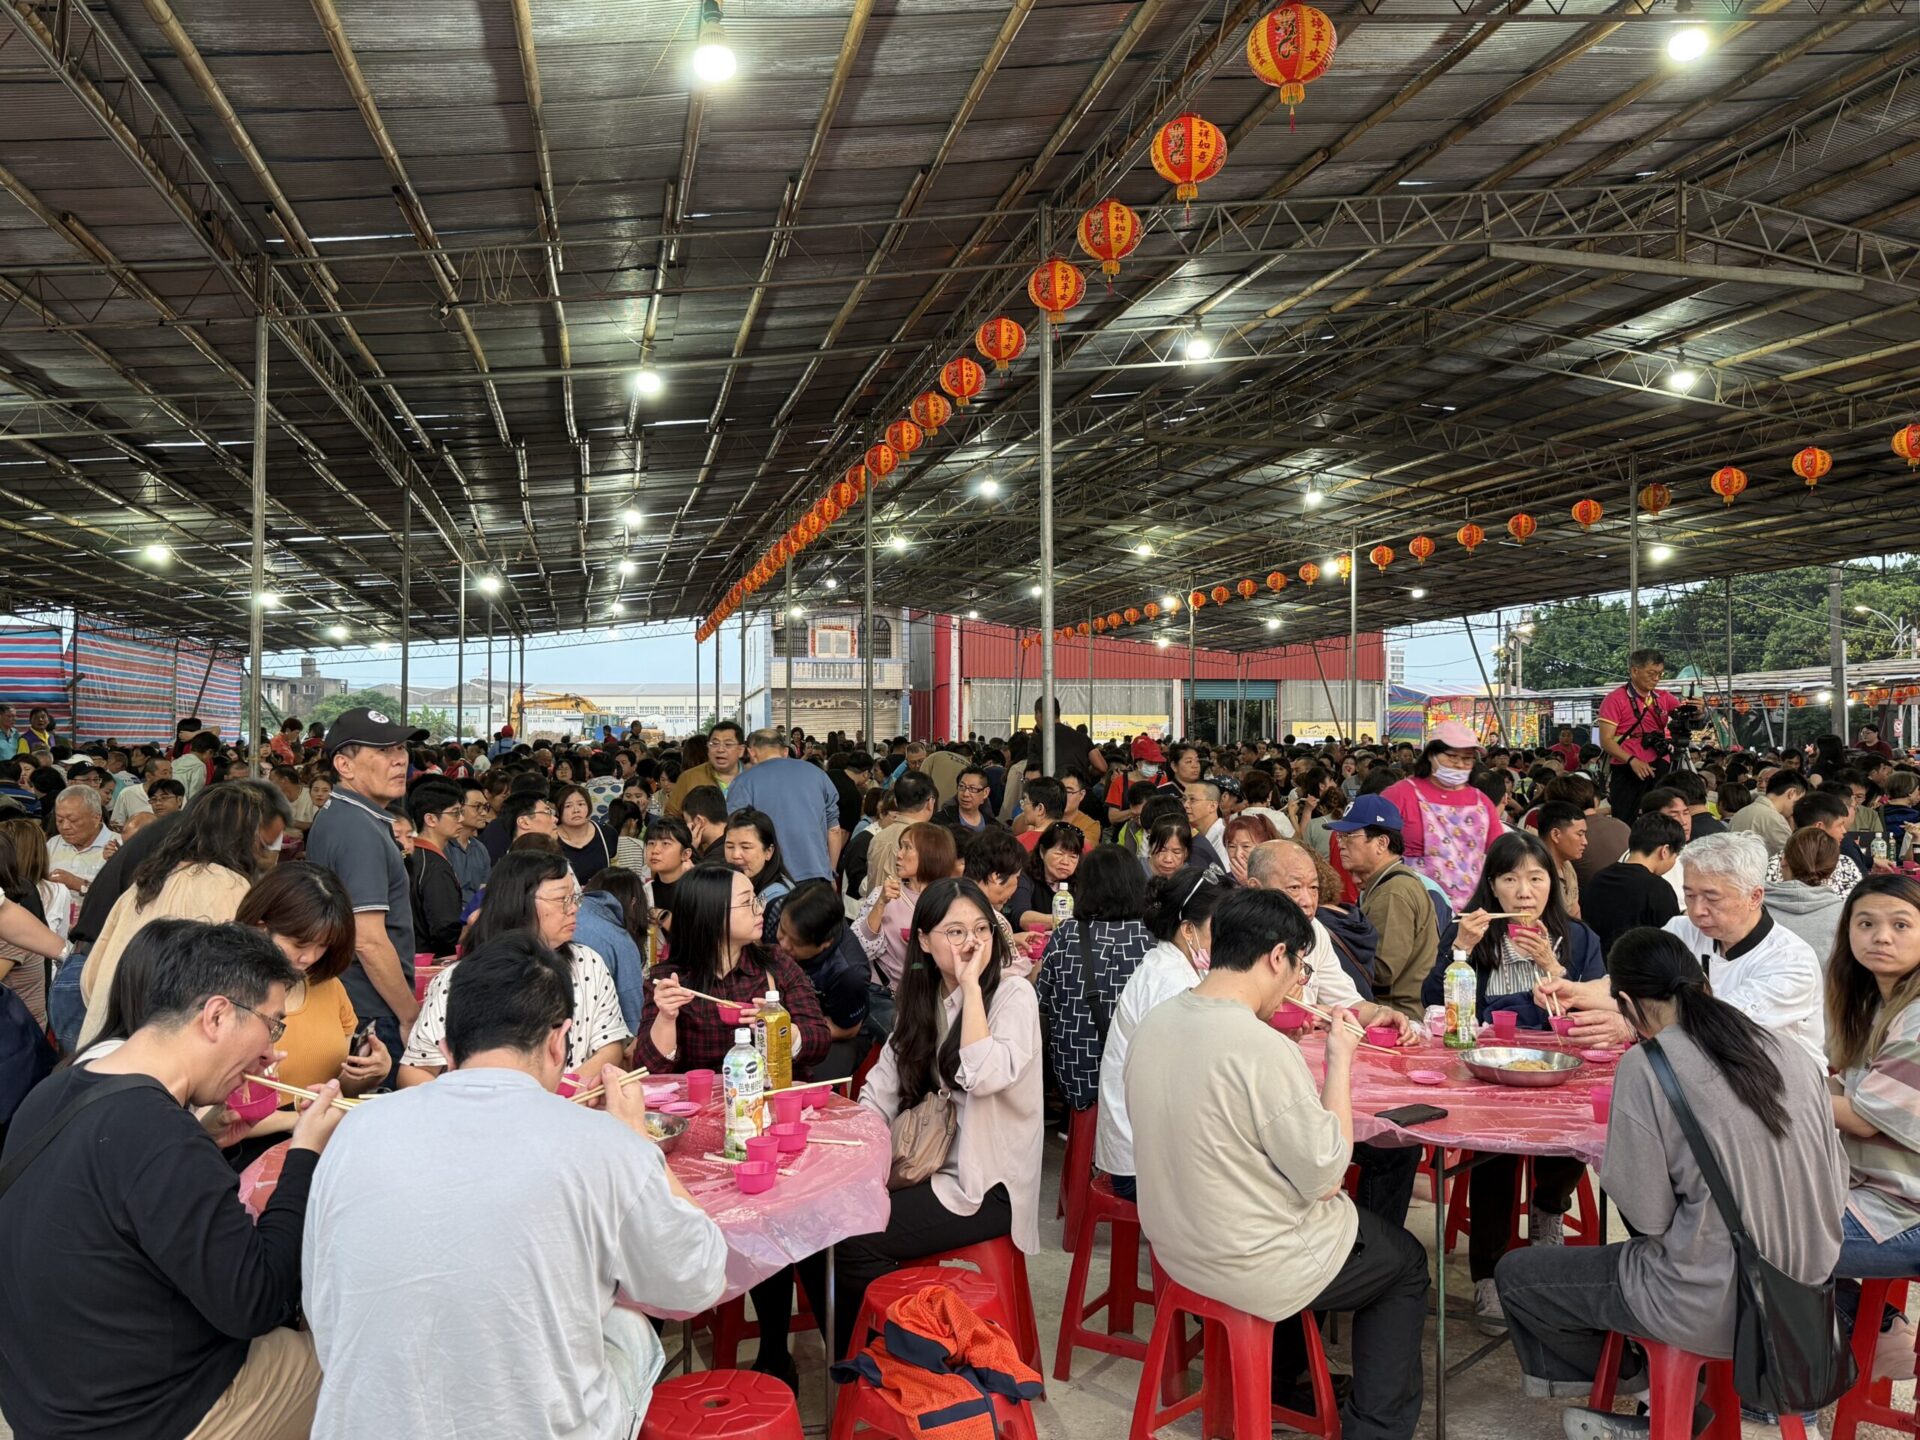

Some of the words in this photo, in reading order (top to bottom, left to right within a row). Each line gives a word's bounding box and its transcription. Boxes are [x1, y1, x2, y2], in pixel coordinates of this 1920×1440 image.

[1195, 121, 1210, 164] 吉祥如意
[1113, 206, 1127, 244] 吉祥如意
[1058, 266, 1072, 301] 合境平安
